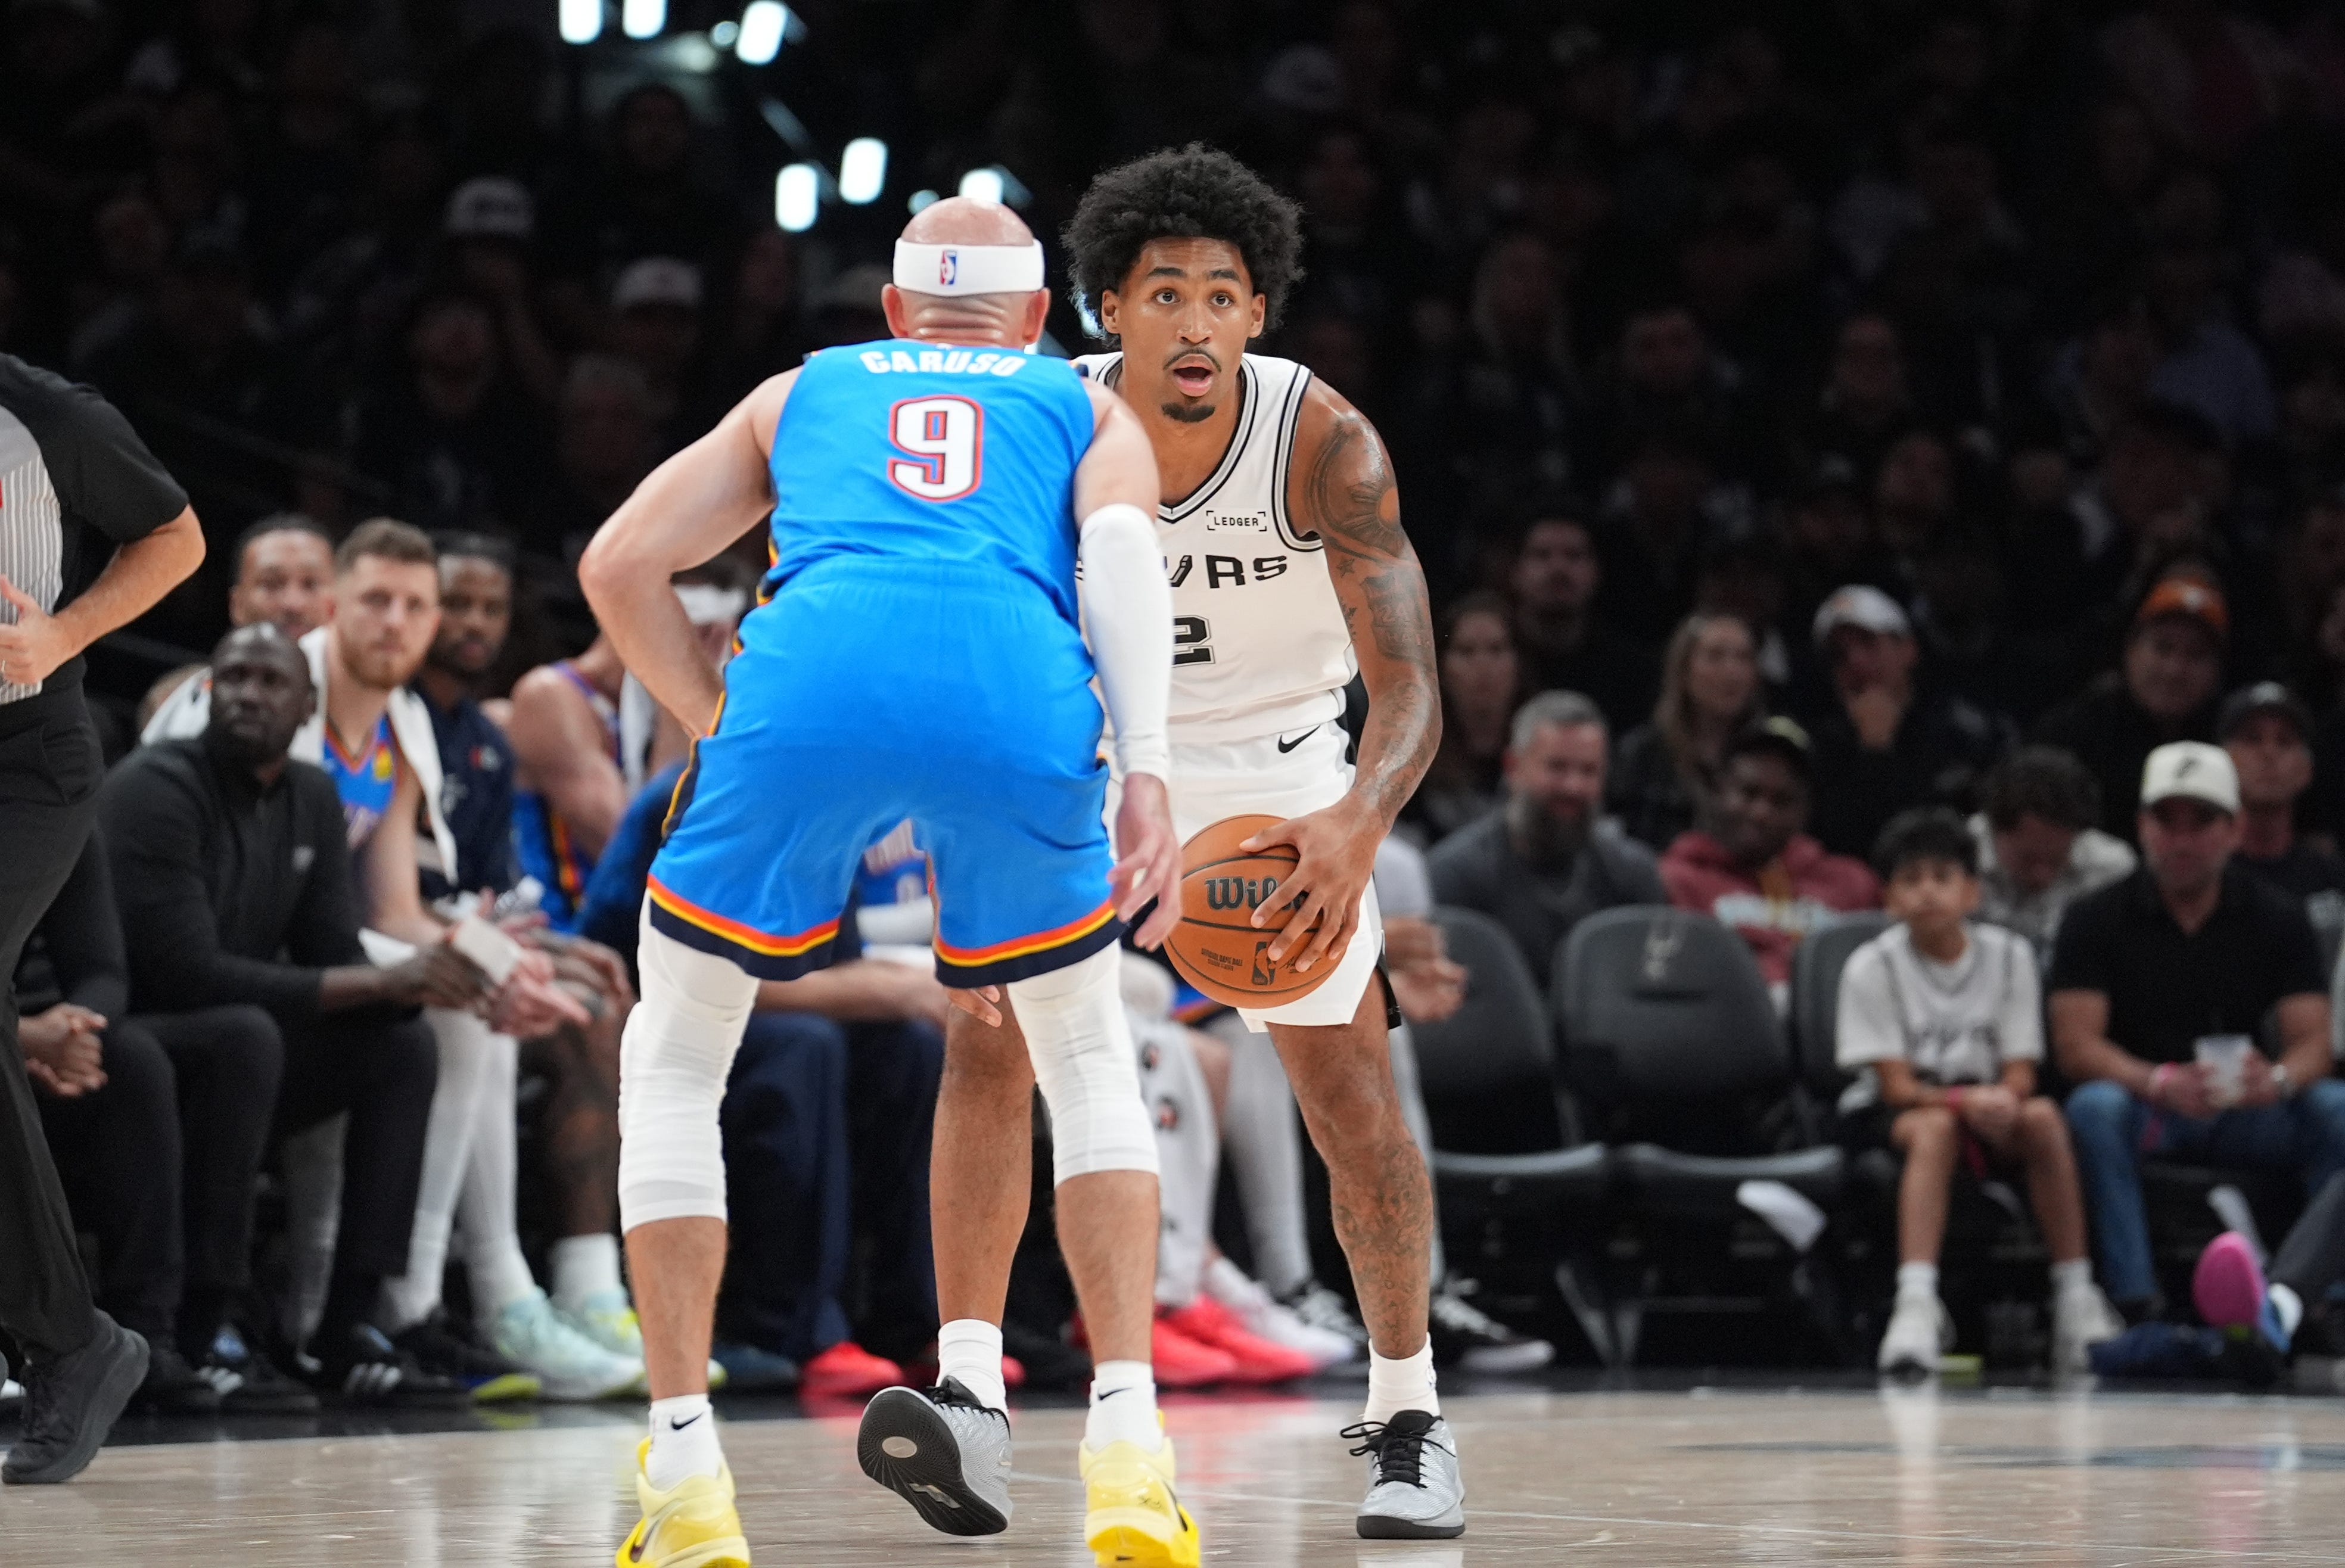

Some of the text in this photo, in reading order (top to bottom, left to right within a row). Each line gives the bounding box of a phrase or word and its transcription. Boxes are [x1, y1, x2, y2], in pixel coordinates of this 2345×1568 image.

[859, 350, 1027, 377] CARUSO
[888, 394, 983, 502] 9
[1214, 517, 1259, 527] LEDGER
[1172, 615, 1215, 668] 2
